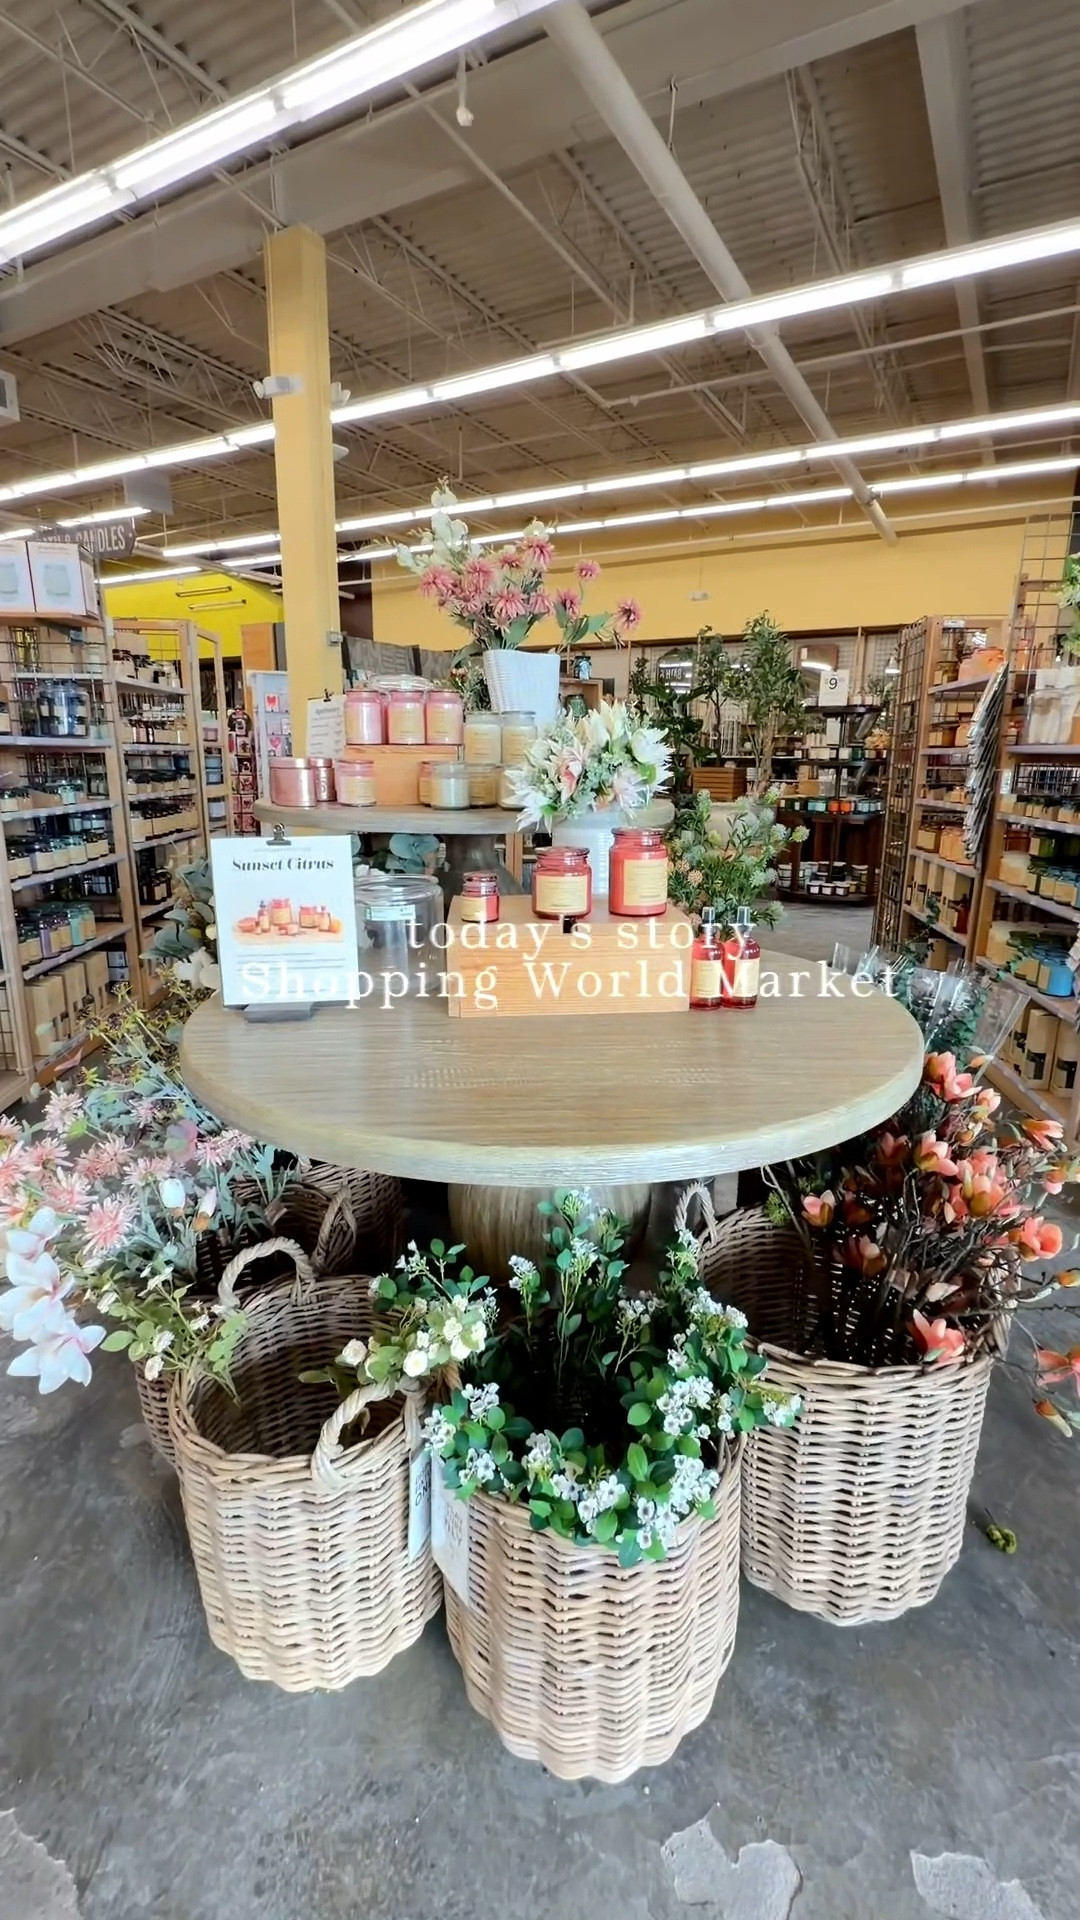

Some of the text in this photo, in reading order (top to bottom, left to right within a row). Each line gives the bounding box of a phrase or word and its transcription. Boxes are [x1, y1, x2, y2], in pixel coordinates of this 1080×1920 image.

[828, 677, 838, 690] 9
[232, 857, 335, 871] Sunset Citrus
